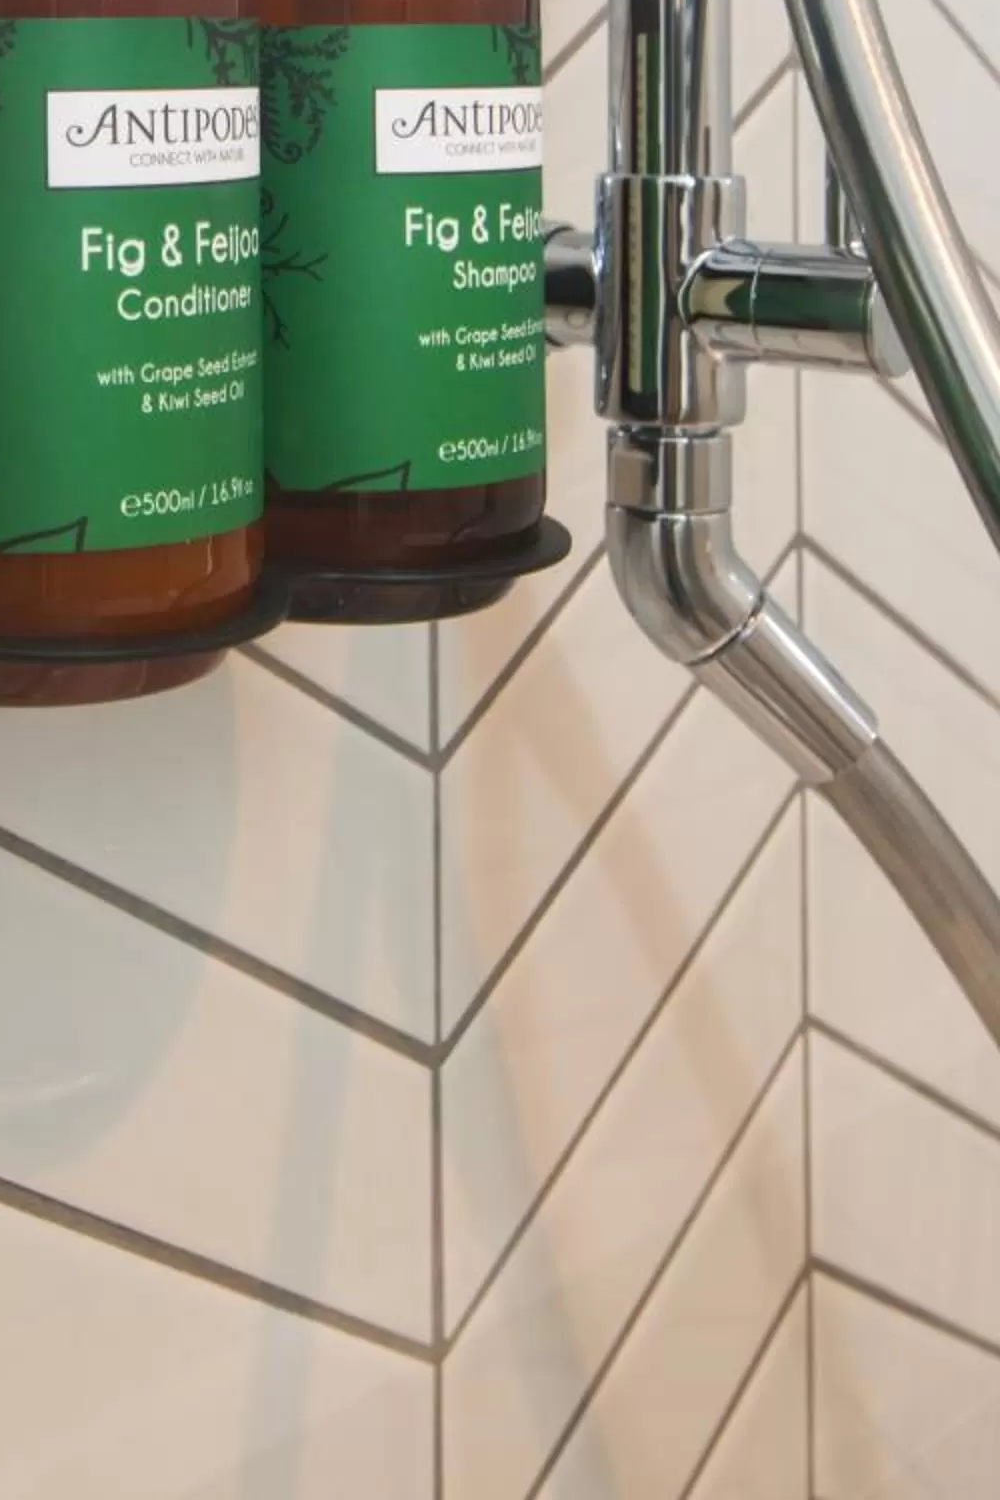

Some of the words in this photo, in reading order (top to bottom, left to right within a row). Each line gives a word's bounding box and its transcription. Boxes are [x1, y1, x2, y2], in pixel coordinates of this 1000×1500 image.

[129, 151, 192, 168] CONNECT
[405, 206, 459, 252] Fig
[472, 204, 489, 243] &
[500, 203, 543, 244] Feijo
[81, 227, 145, 277] Fig
[161, 224, 182, 267] &
[453, 260, 536, 292] Shampoo
[117, 284, 252, 321] Conditioner
[419, 328, 450, 347] with
[455, 326, 498, 348] Grape
[97, 365, 134, 387] with
[141, 362, 193, 386] Grape
[198, 353, 229, 377] Seed
[456, 353, 466, 371] &
[470, 352, 494, 370] Kiwi
[141, 393, 153, 413] &
[158, 390, 189, 412] Kiwi
[194, 382, 227, 408] Seed
[502, 434, 509, 455] /
[198, 483, 207, 509] /
